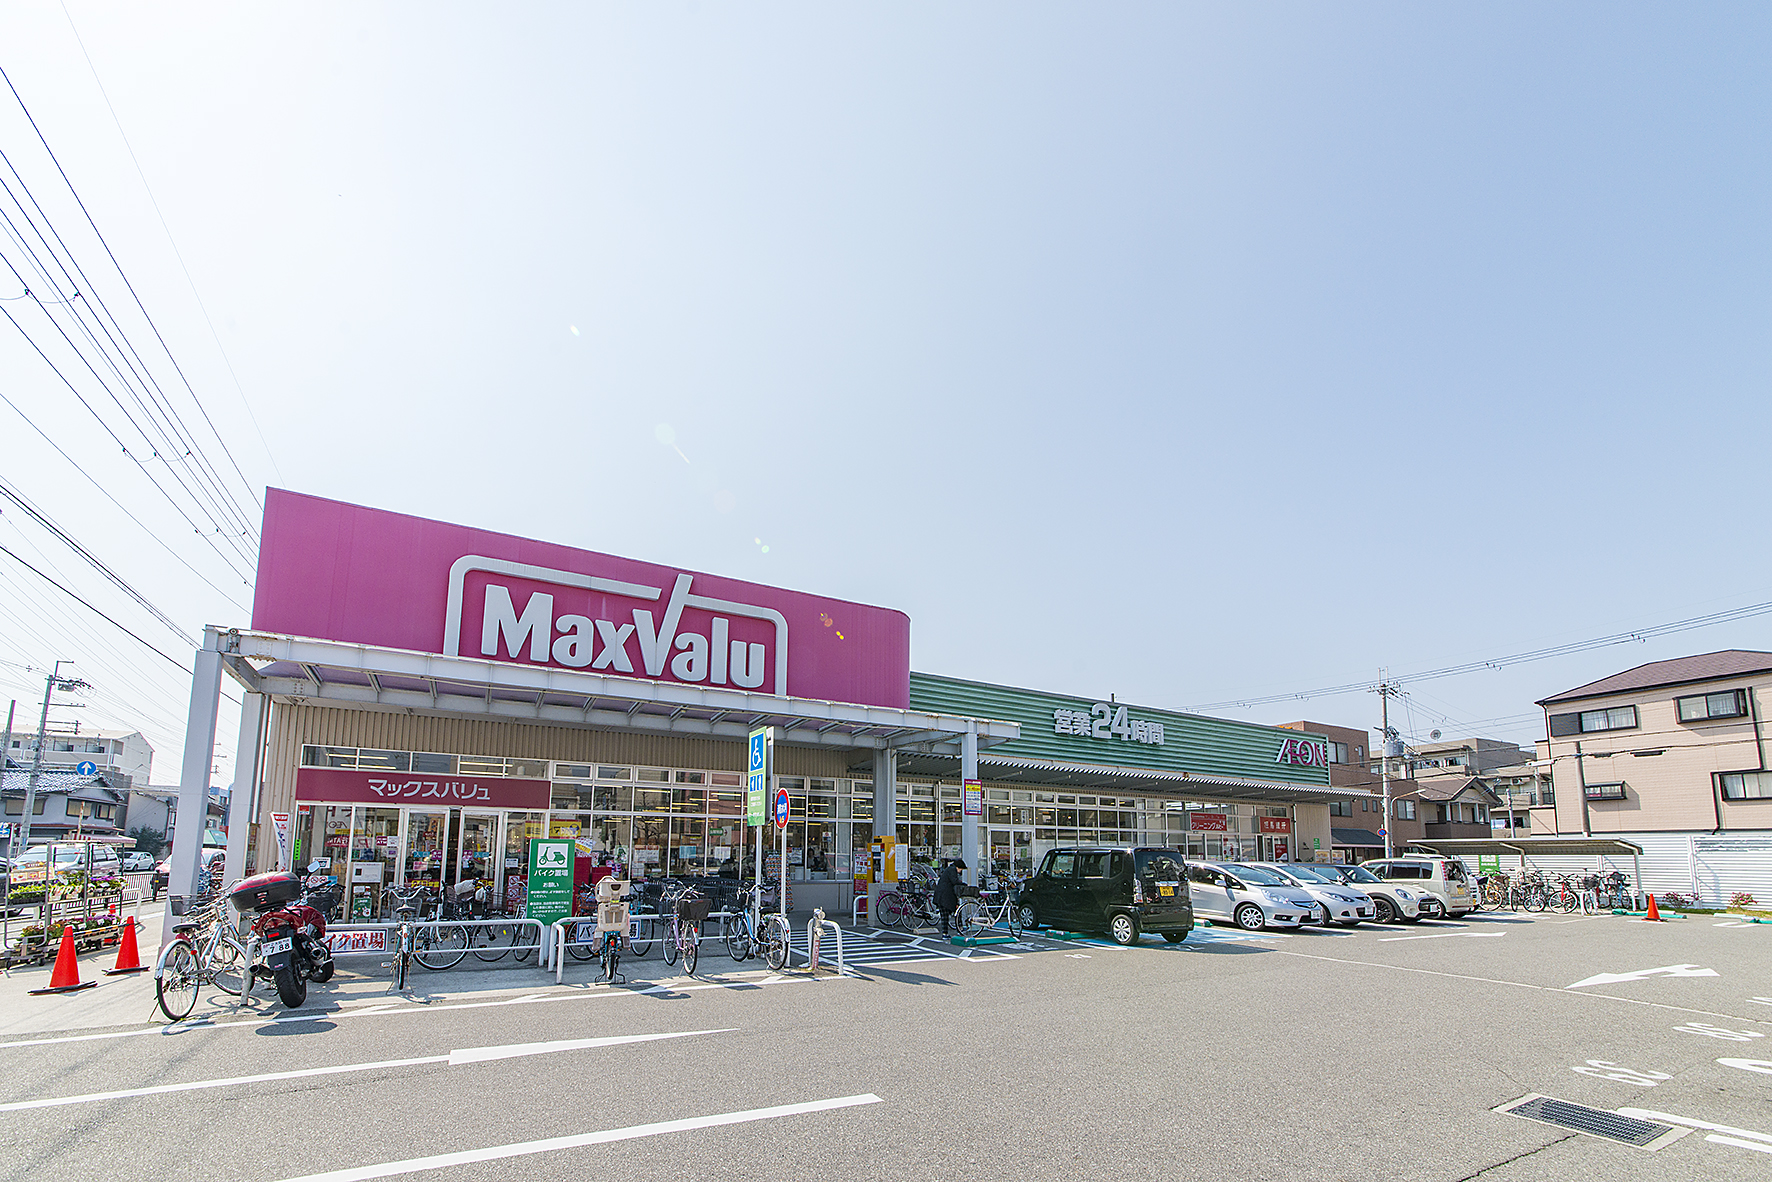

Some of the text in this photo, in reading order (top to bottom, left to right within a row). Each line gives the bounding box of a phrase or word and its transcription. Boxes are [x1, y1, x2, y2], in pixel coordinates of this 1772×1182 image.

[481, 574, 766, 689] MaxValu
[1054, 703, 1164, 745] 営業24時間
[368, 779, 491, 800] マックスバリュ
[533, 869, 569, 877] バイク置場
[324, 932, 385, 950] イク置場
